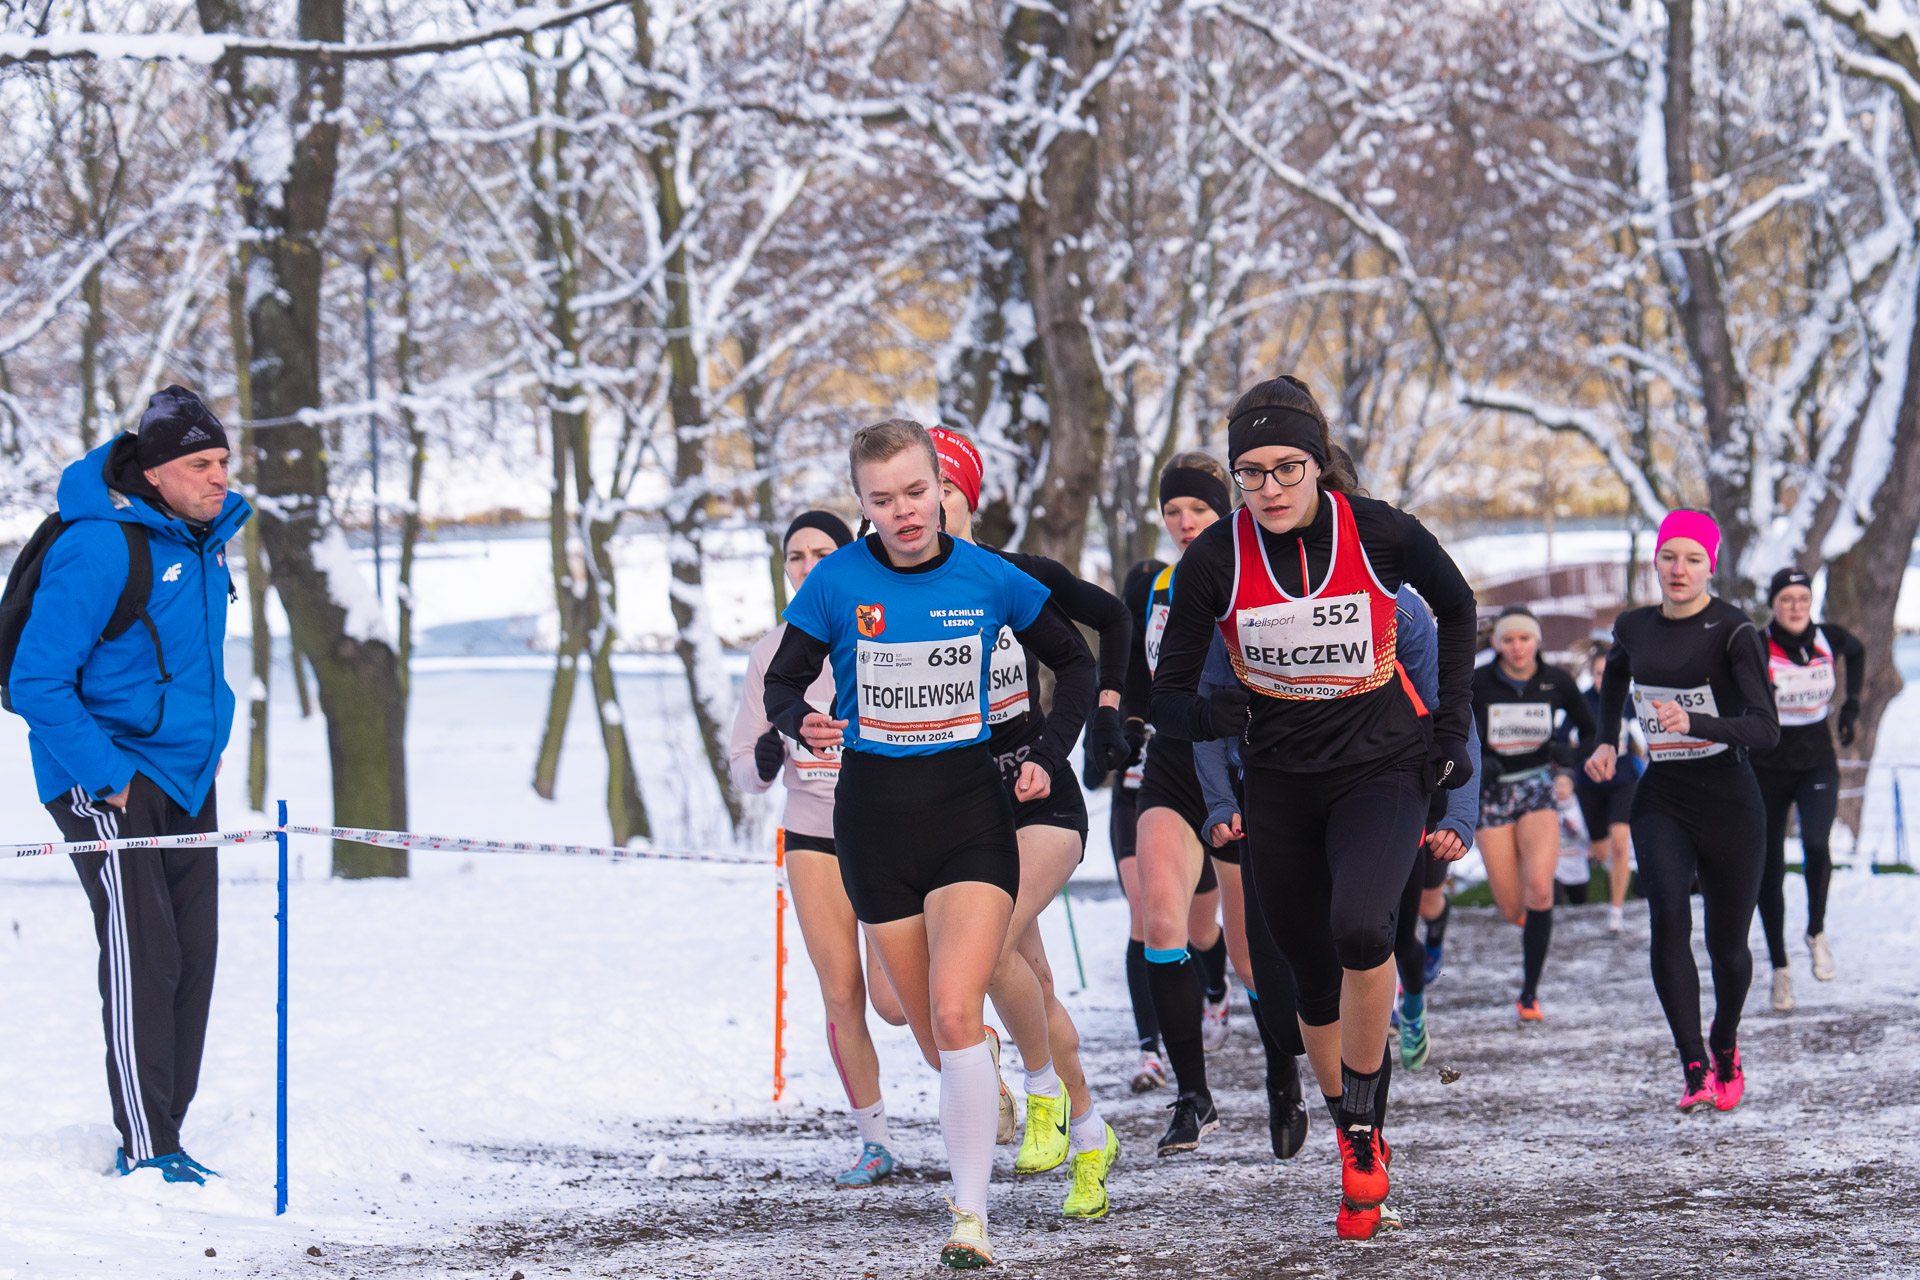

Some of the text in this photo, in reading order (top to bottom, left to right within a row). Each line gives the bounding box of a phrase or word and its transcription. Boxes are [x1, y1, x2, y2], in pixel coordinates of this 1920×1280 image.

[180, 434, 211, 446] adidas
[162, 563, 182, 582] 4F
[930, 609, 984, 618] UKS ACHILLES
[1312, 602, 1360, 627] 552
[1248, 615, 1296, 628] Bellsport
[873, 651, 894, 663] 770
[927, 645, 972, 667] 638
[1244, 640, 1368, 667] BEŁCZEW
[988, 664, 1023, 691] SKA
[862, 680, 975, 709] TEOFILEWSKA
[1274, 683, 1343, 696] BYTOM 2024
[1674, 692, 1705, 708] 453
[887, 731, 954, 743] BYTOM 2024
[1657, 751, 1686, 759] BYTOM
